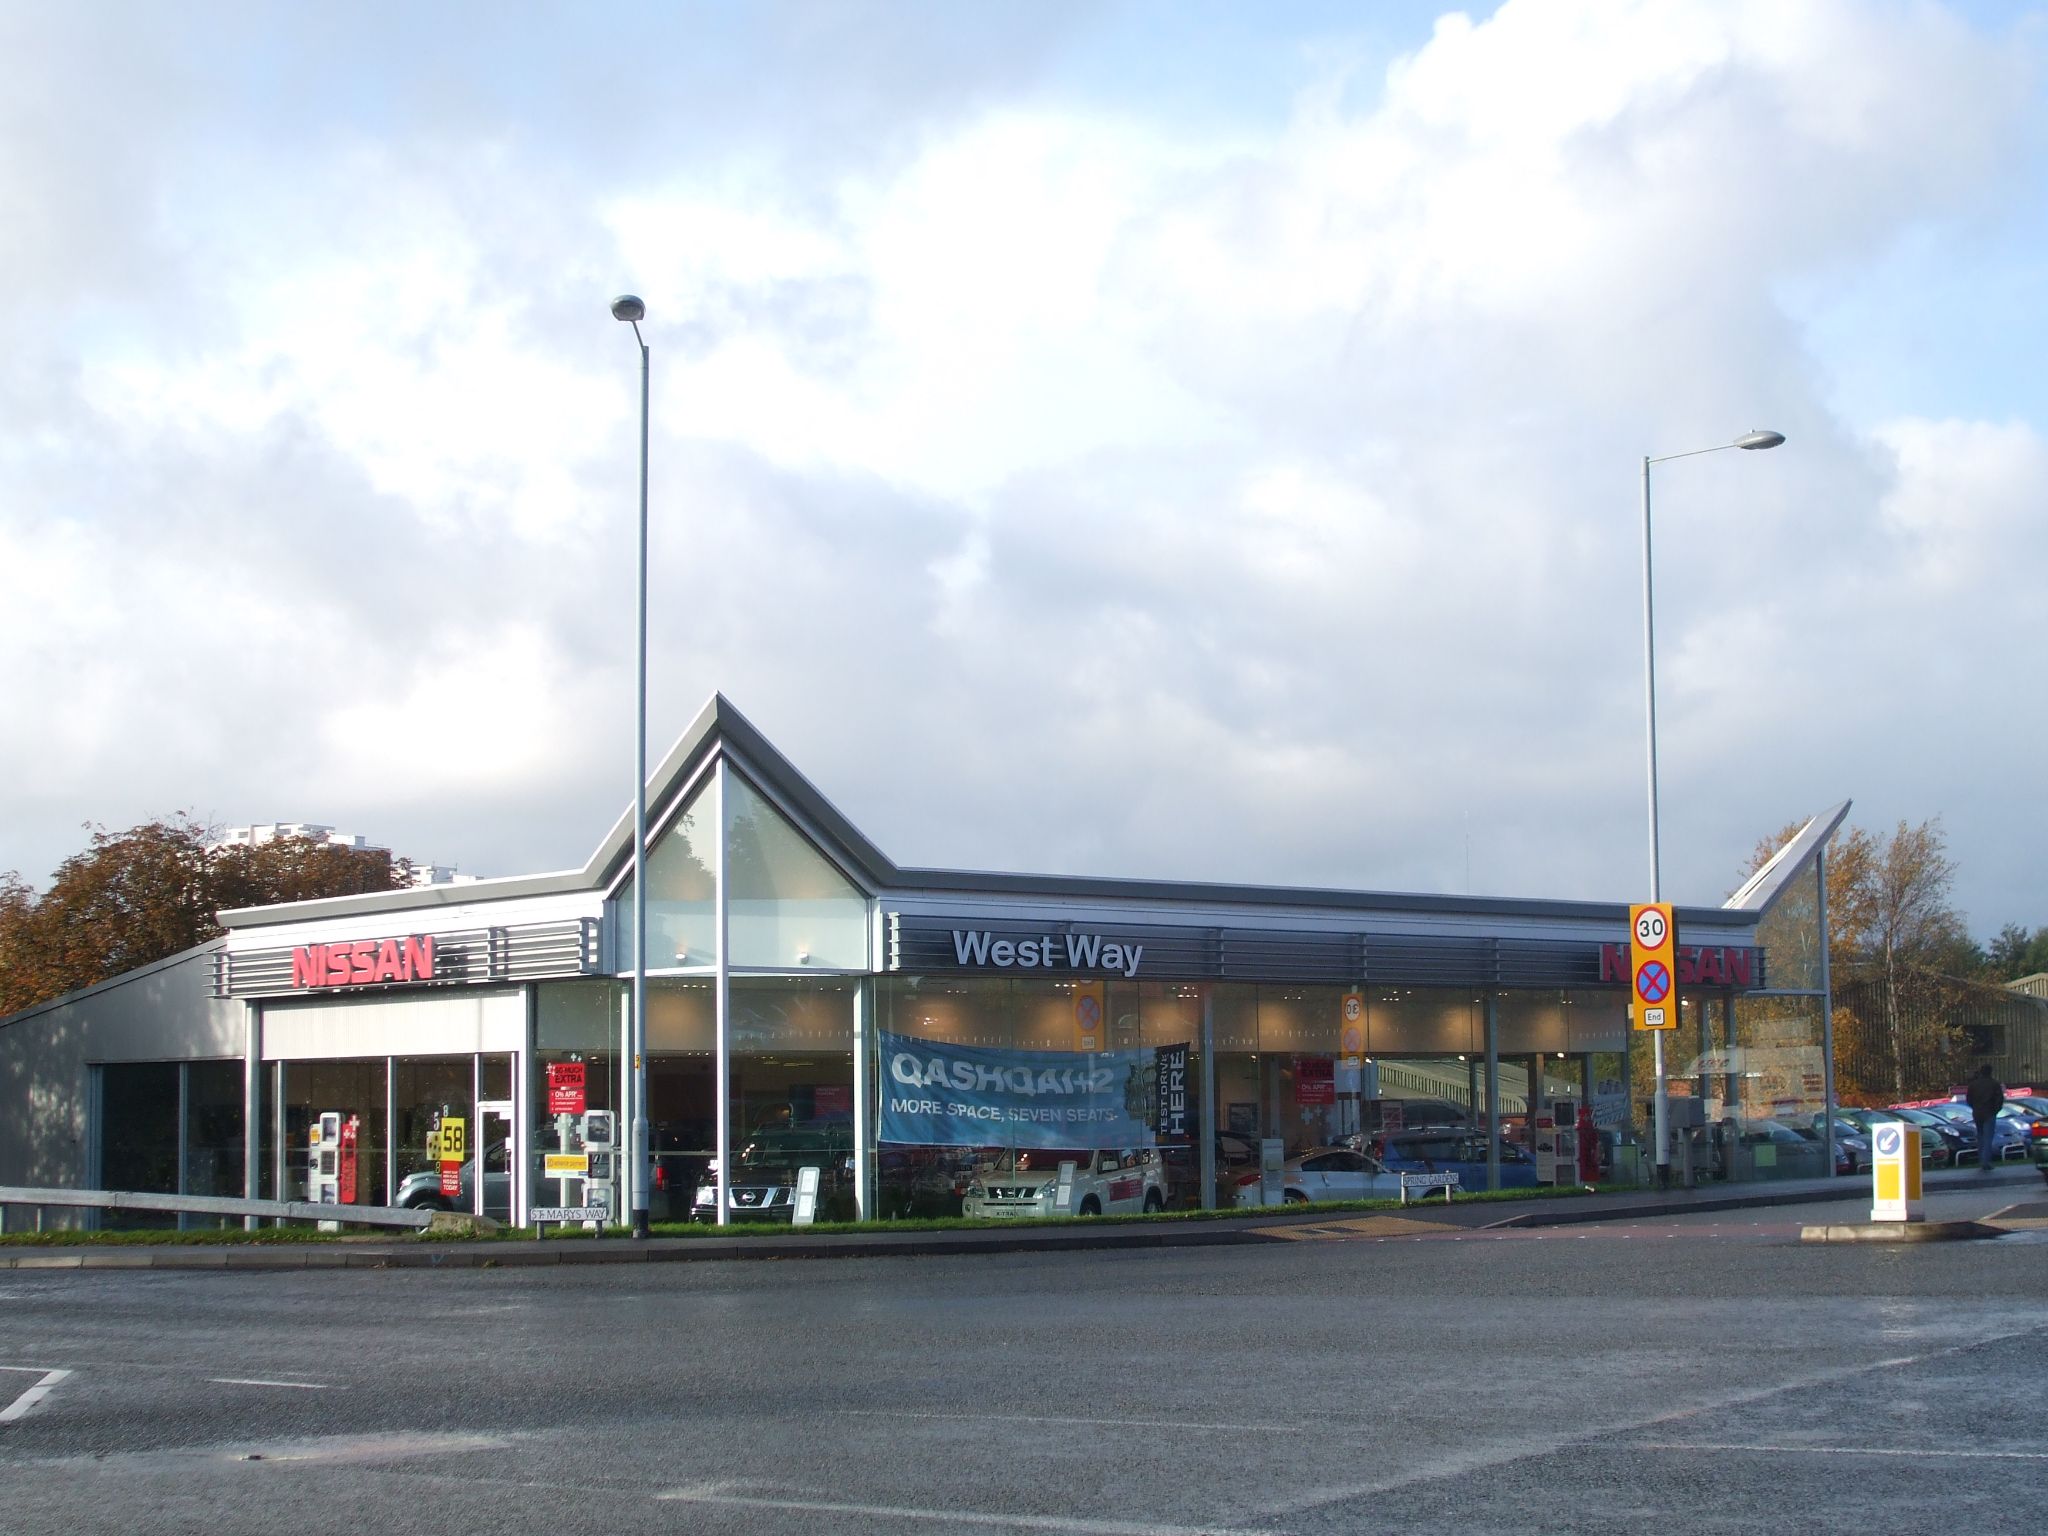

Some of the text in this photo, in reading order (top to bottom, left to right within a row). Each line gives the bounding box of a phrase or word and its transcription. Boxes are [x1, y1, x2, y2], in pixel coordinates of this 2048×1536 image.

[1639, 918, 1663, 937] 30
[292, 935, 434, 988] NISSAN
[952, 930, 1143, 977] West Way
[1602, 944, 1750, 984] NSAN
[1648, 1013, 1661, 1021] End
[555, 1075, 582, 1084] EXTRA
[891, 1053, 1114, 1096] QASHQAI+2
[1161, 1054, 1169, 1095] DRIVE
[1170, 1050, 1185, 1134] HERE
[891, 1098, 942, 1115] MORE
[945, 1103, 1004, 1122] SPACE,
[1008, 1108, 1062, 1122] SEVEN
[444, 1126, 463, 1152] 58
[1403, 1174, 1458, 1185] SPRING GARDENS
[547, 1209, 582, 1219] MARYS
[585, 1209, 606, 1219] WAY
